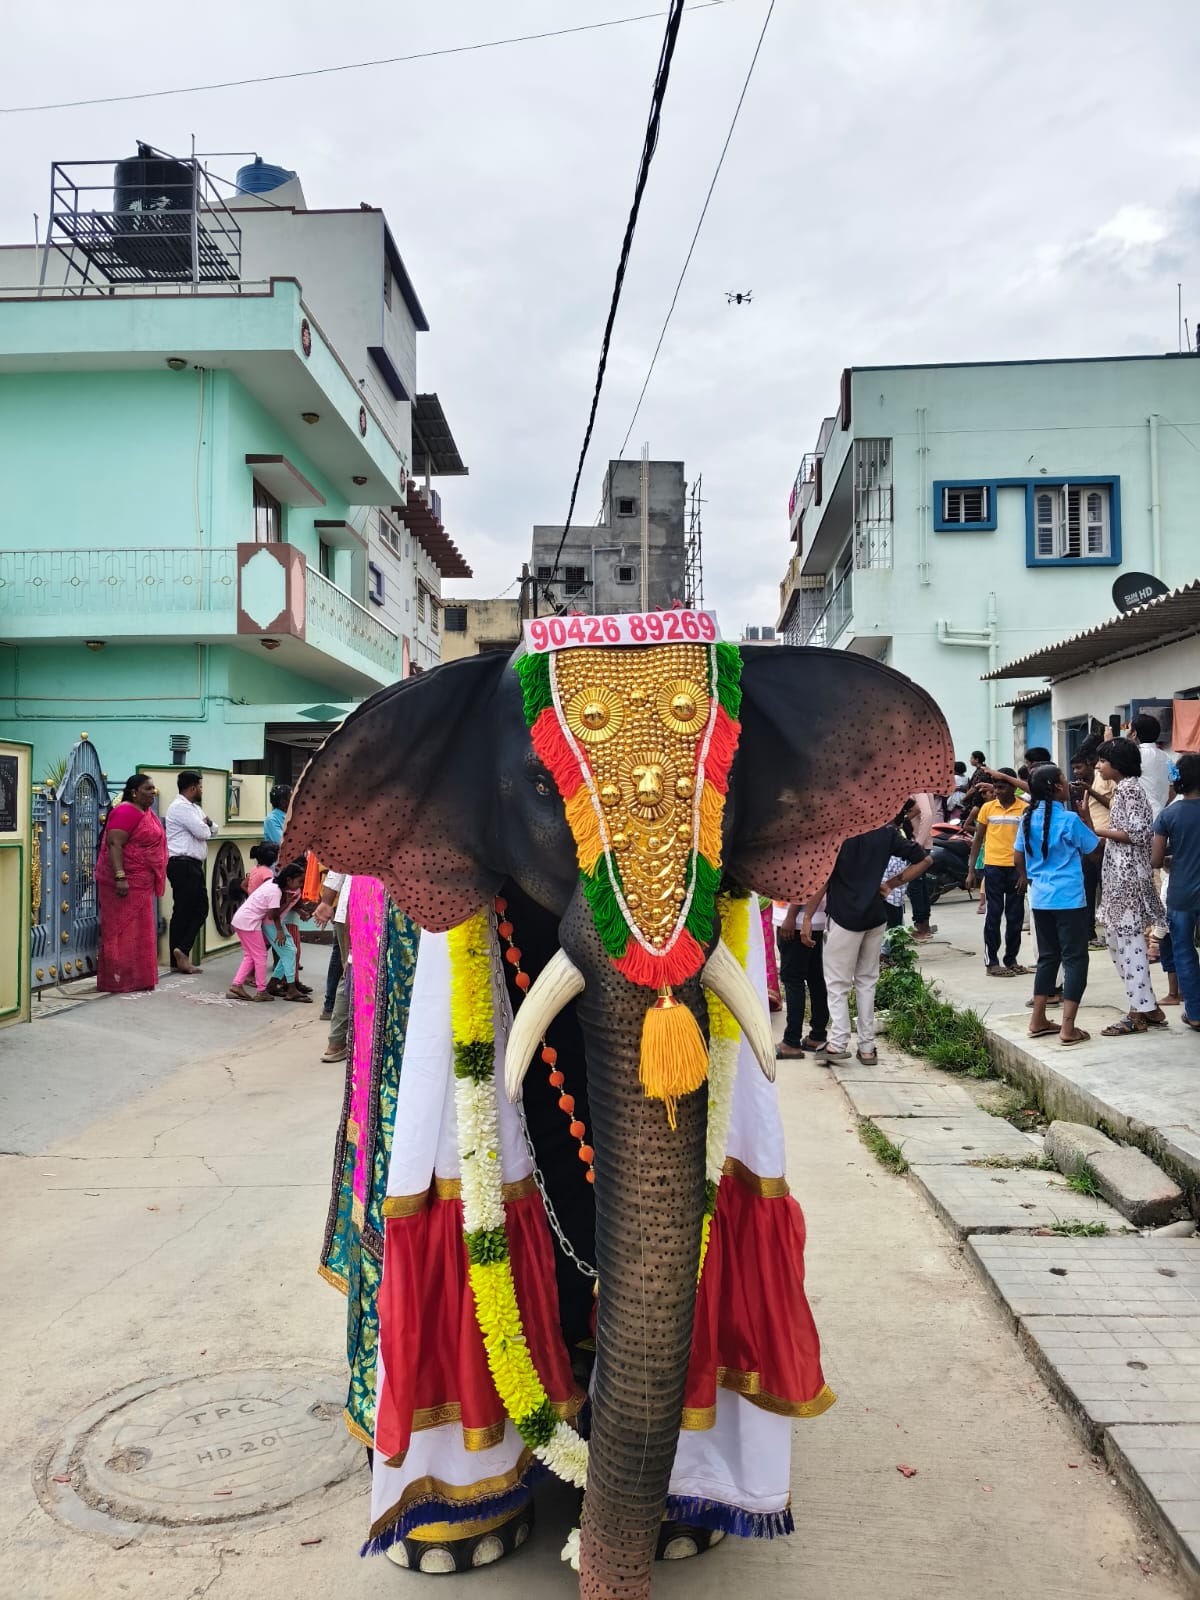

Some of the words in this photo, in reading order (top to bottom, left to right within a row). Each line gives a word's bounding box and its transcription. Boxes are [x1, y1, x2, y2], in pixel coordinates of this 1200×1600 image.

[1124, 592, 1138, 602] SUN
[1138, 586, 1153, 600] HD
[530, 617, 621, 651] 90426
[628, 611, 716, 642] 89269
[184, 1402, 255, 1425] TPC
